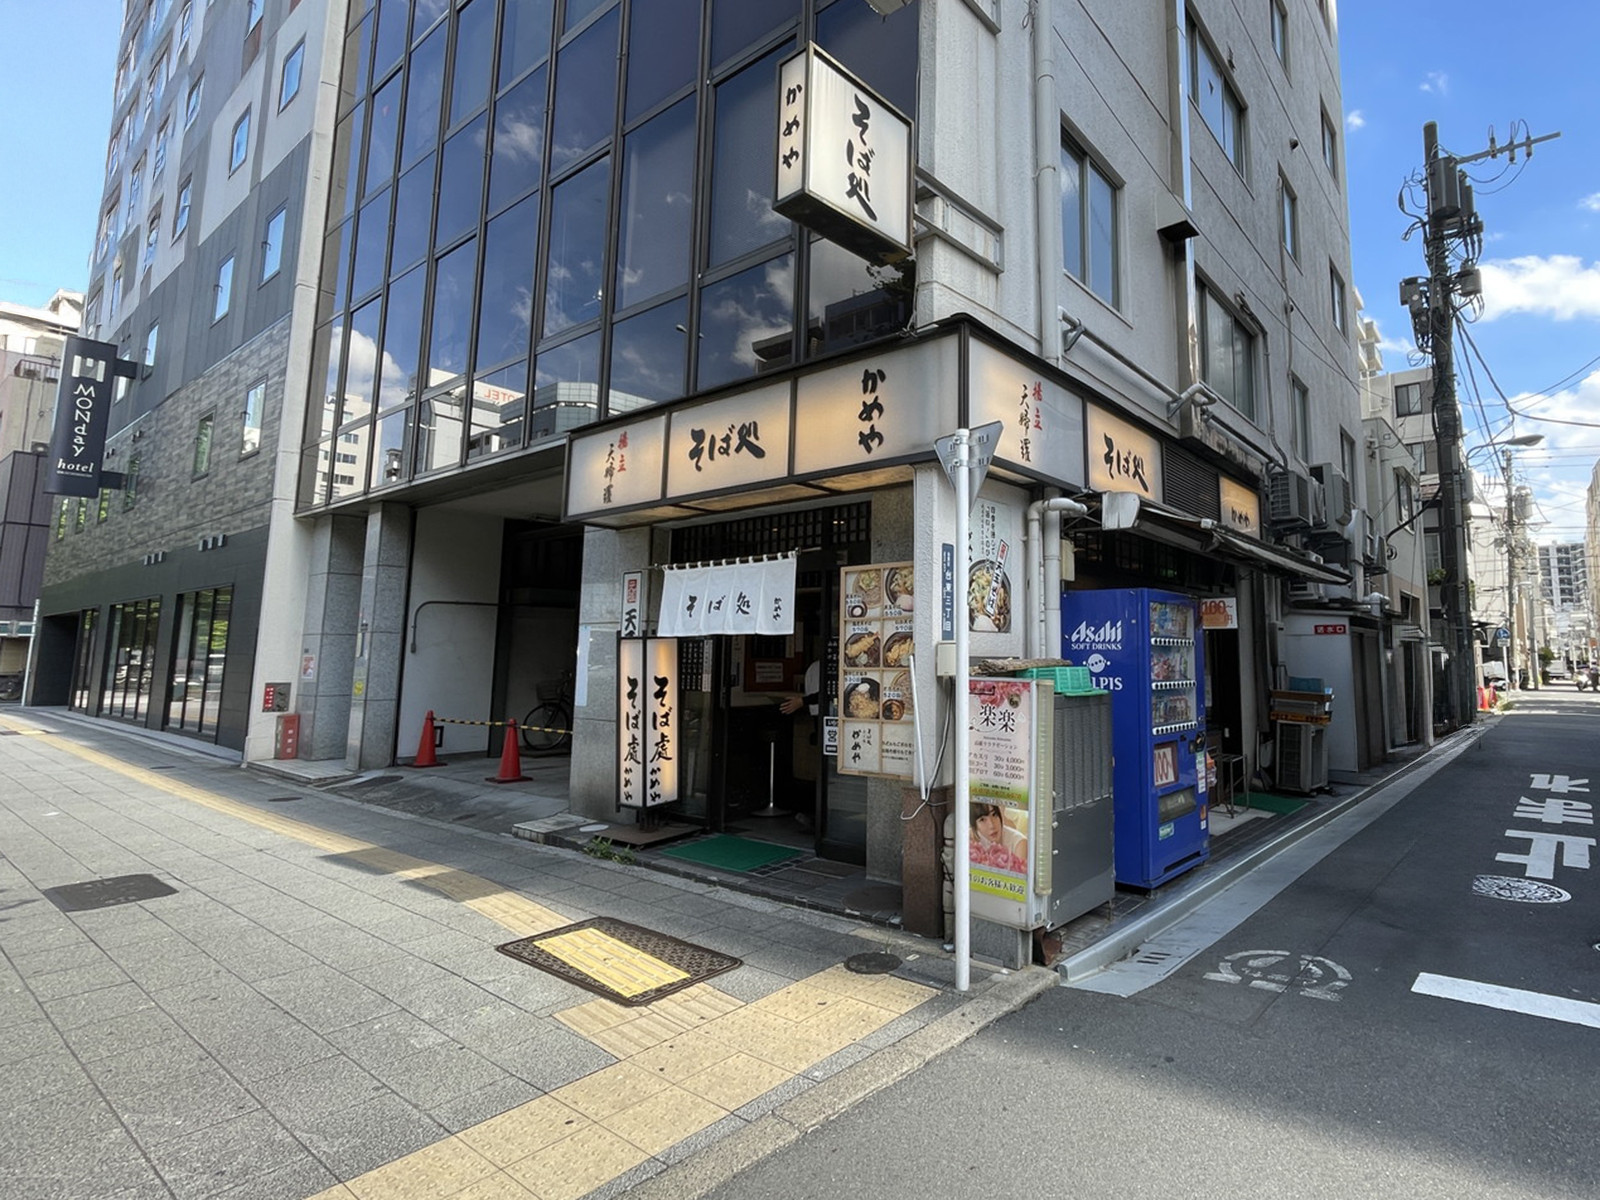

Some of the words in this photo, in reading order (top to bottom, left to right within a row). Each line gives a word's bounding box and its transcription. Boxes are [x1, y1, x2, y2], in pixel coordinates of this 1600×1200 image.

[782, 84, 802, 169] かめや
[845, 93, 878, 222] そば処
[858, 368, 887, 455] かめや
[689, 420, 766, 472] そば処
[1103, 432, 1149, 493] そば処
[57, 458, 94, 473] hotel
[1231, 506, 1250, 527] かめや
[685, 591, 751, 618] そば処
[773, 597, 783, 621] かめや
[1071, 620, 1122, 643] Asahi
[1092, 677, 1123, 691] LPIS
[980, 704, 1016, 733] 楽楽
[851, 729, 862, 763] かめや
[623, 767, 633, 802] かめや
[649, 766, 661, 802] かめや
